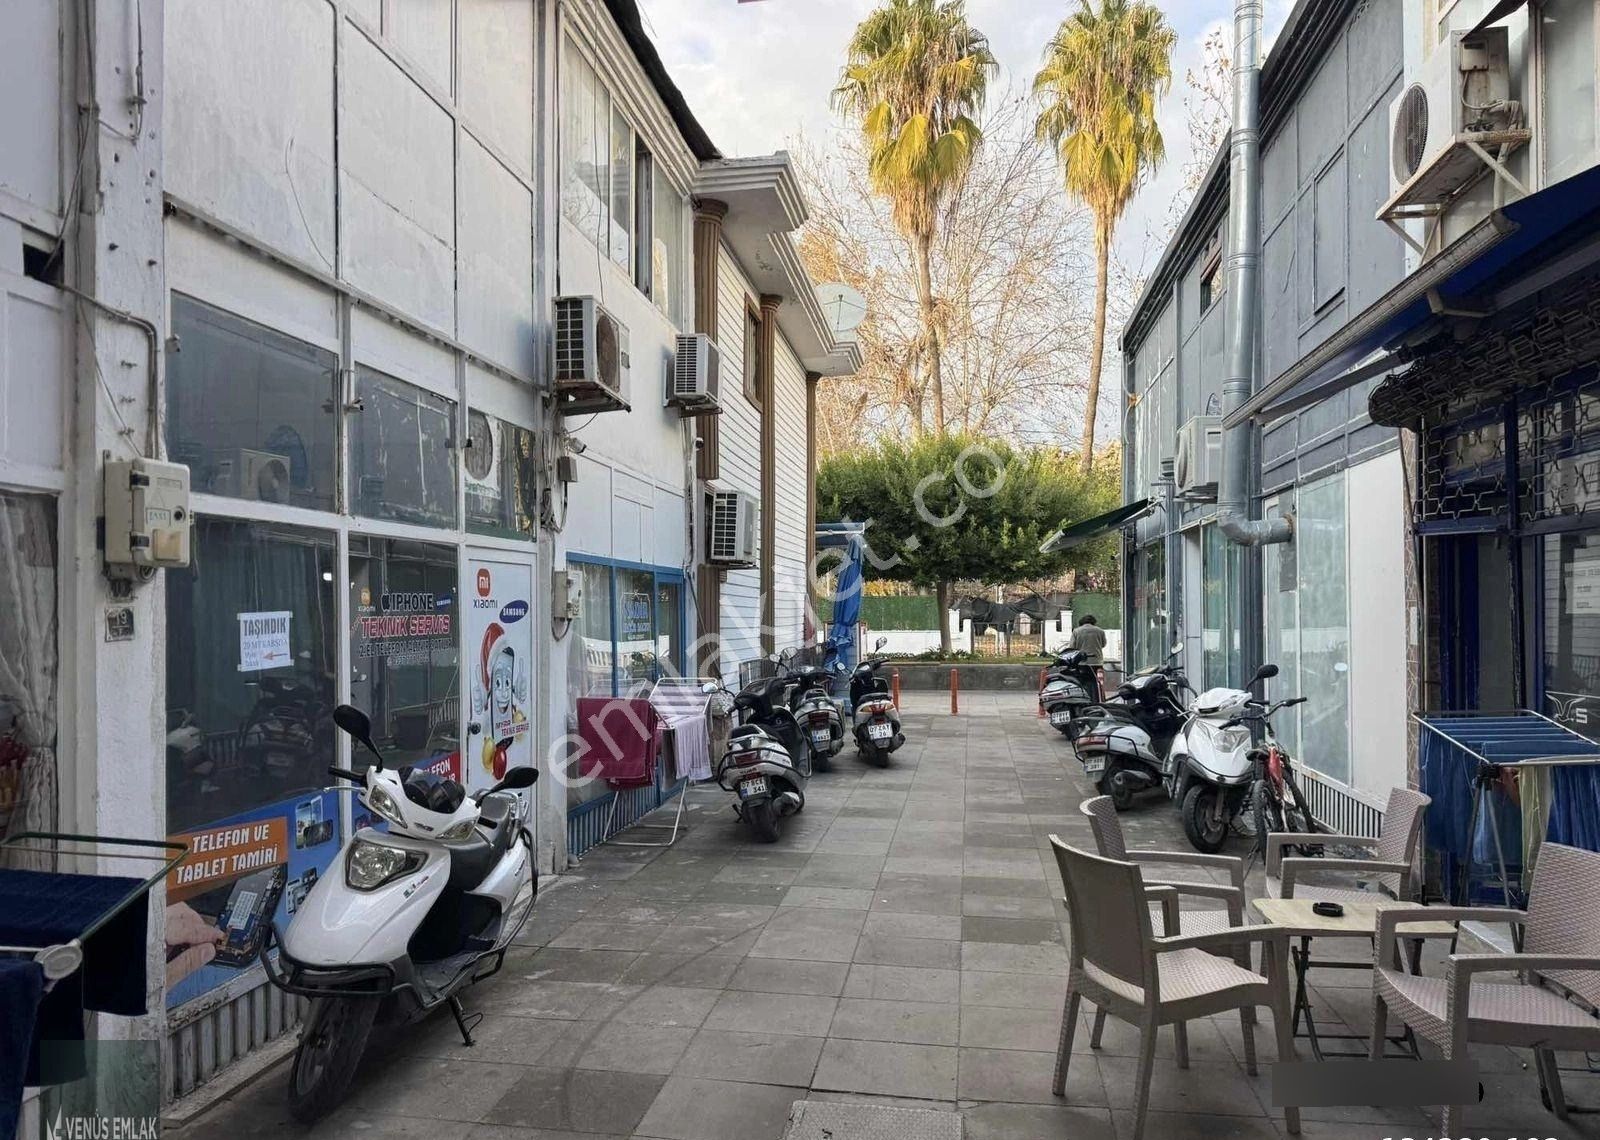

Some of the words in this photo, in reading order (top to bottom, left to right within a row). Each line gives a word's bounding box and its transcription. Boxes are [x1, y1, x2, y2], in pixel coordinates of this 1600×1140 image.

[391, 592, 434, 611] IPHONE
[243, 617, 286, 638] TAŞINDIK
[192, 827, 250, 854] TELEFON
[254, 823, 270, 841] VE
[176, 857, 228, 884] TABLET
[231, 844, 278, 872] TAMİRİ
